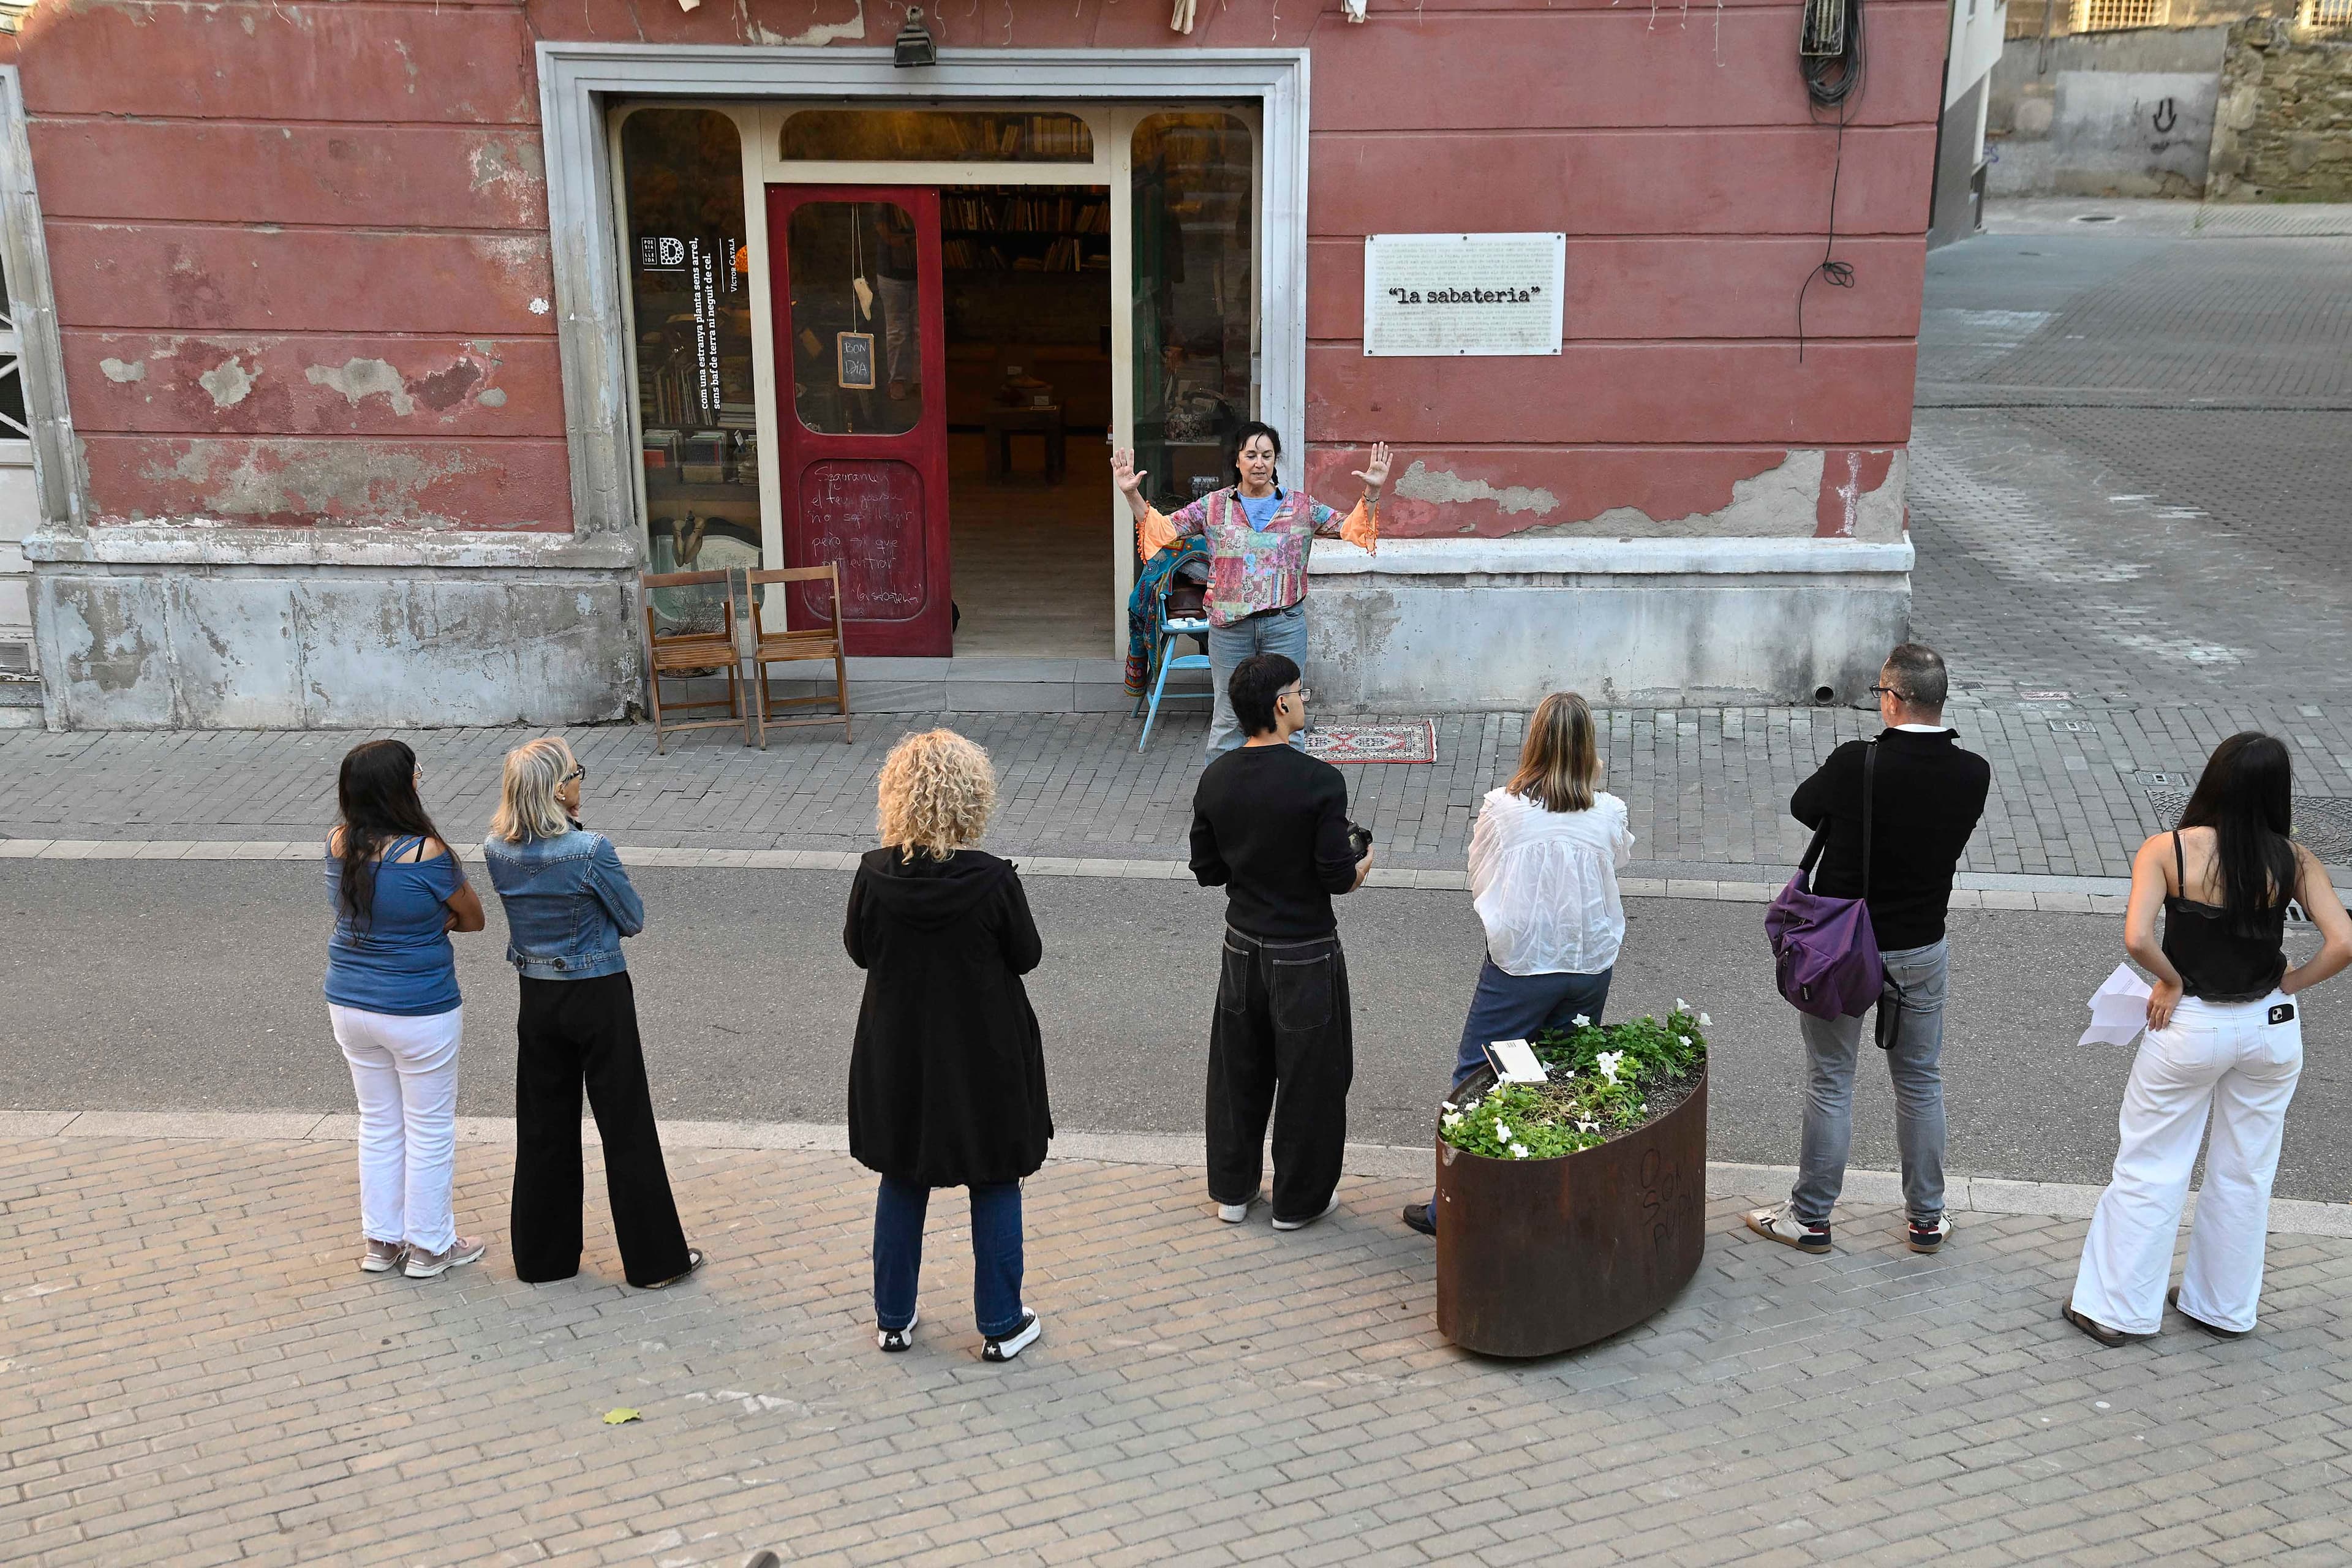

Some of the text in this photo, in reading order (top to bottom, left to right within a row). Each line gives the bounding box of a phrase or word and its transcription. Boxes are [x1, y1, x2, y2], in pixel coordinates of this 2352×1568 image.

[689, 237, 699, 266] arrel,
[702, 252, 712, 270] cel.
[704, 271, 713, 284] de
[694, 292, 704, 323] planta
[704, 285, 716, 317] neguit
[707, 318, 716, 328] ni
[697, 325, 706, 368] estranya
[845, 342, 867, 353] BON
[709, 356, 718, 369] de
[710, 369, 719, 386] baf
[812, 489, 822, 509] el
